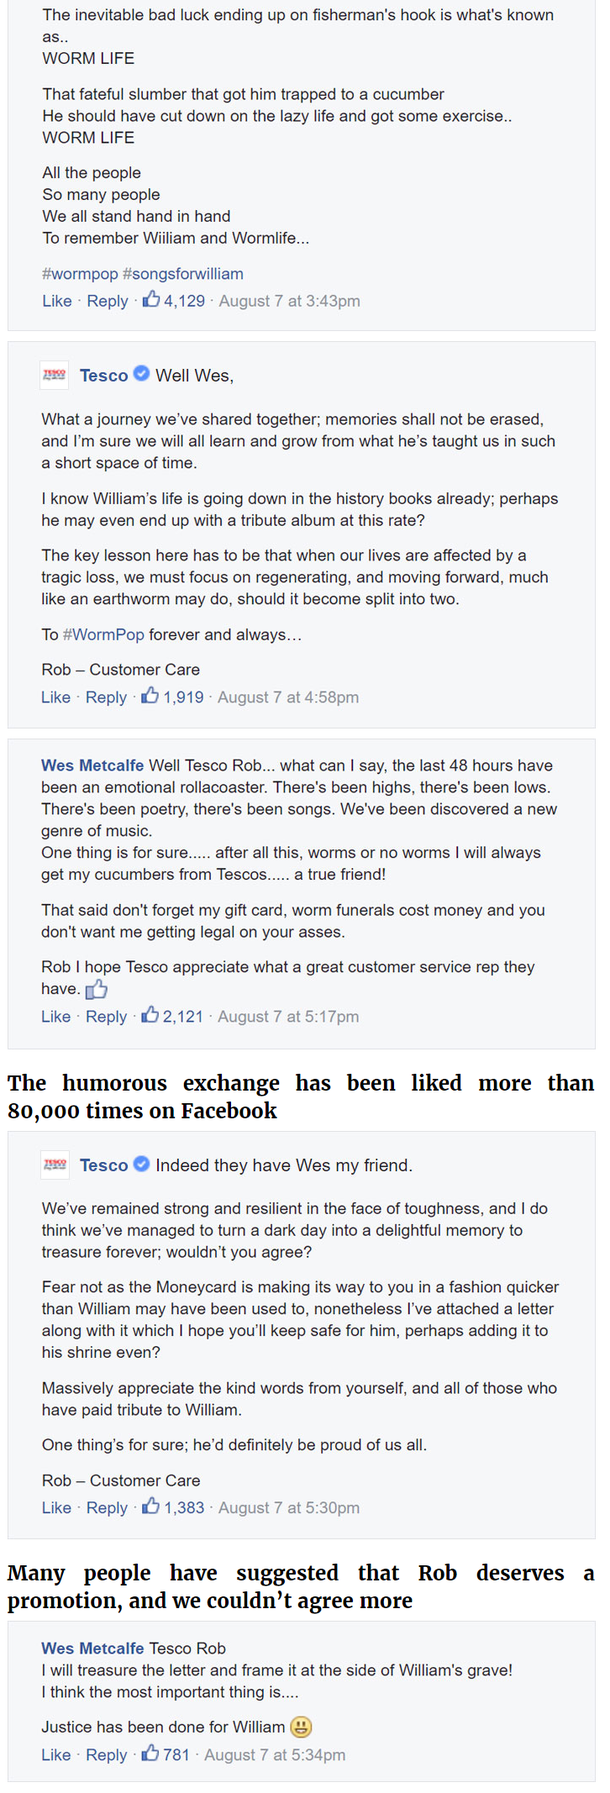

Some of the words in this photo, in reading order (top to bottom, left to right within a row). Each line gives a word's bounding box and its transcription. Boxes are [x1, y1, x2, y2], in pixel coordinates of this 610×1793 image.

[42, 268, 118, 282] #wormpop
[123, 267, 243, 283] #songsforwilliam
[80, 369, 128, 382] Tesco
[155, 369, 189, 382] Well
[194, 369, 233, 384] Wes,
